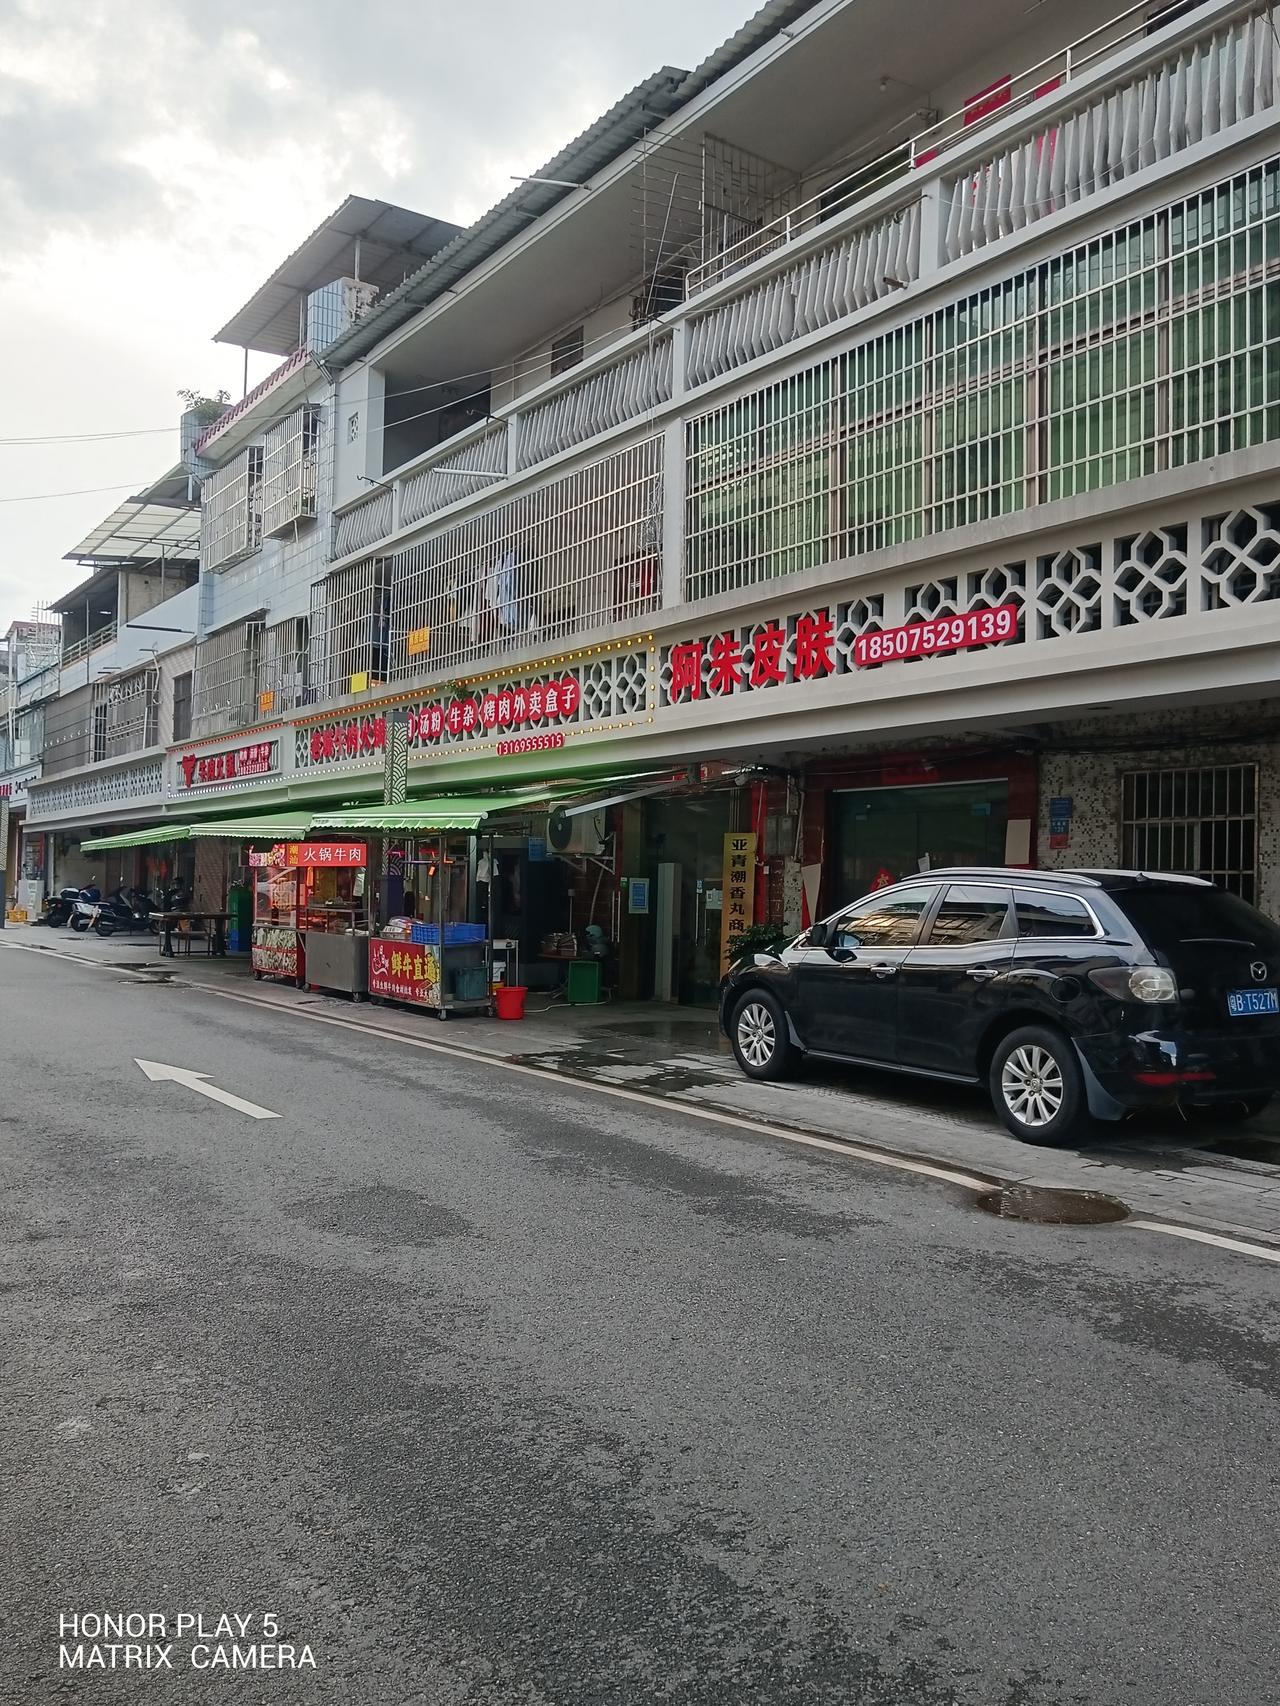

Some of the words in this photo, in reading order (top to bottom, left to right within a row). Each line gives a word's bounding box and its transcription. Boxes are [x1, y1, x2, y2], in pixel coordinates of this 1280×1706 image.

[671, 610, 836, 702] 阿朱皮肤
[858, 610, 1012, 662] 18507529139
[420, 713, 441, 735] 汤粉
[450, 705, 475, 729] 牛杂
[483, 684, 576, 723] 烤肉外卖盒子
[498, 735, 563, 755] 13169555515
[304, 847, 361, 862] 火锅牛肉
[729, 839, 747, 936] 亚青潮香丸商
[391, 950, 439, 983] 鲜牛直通
